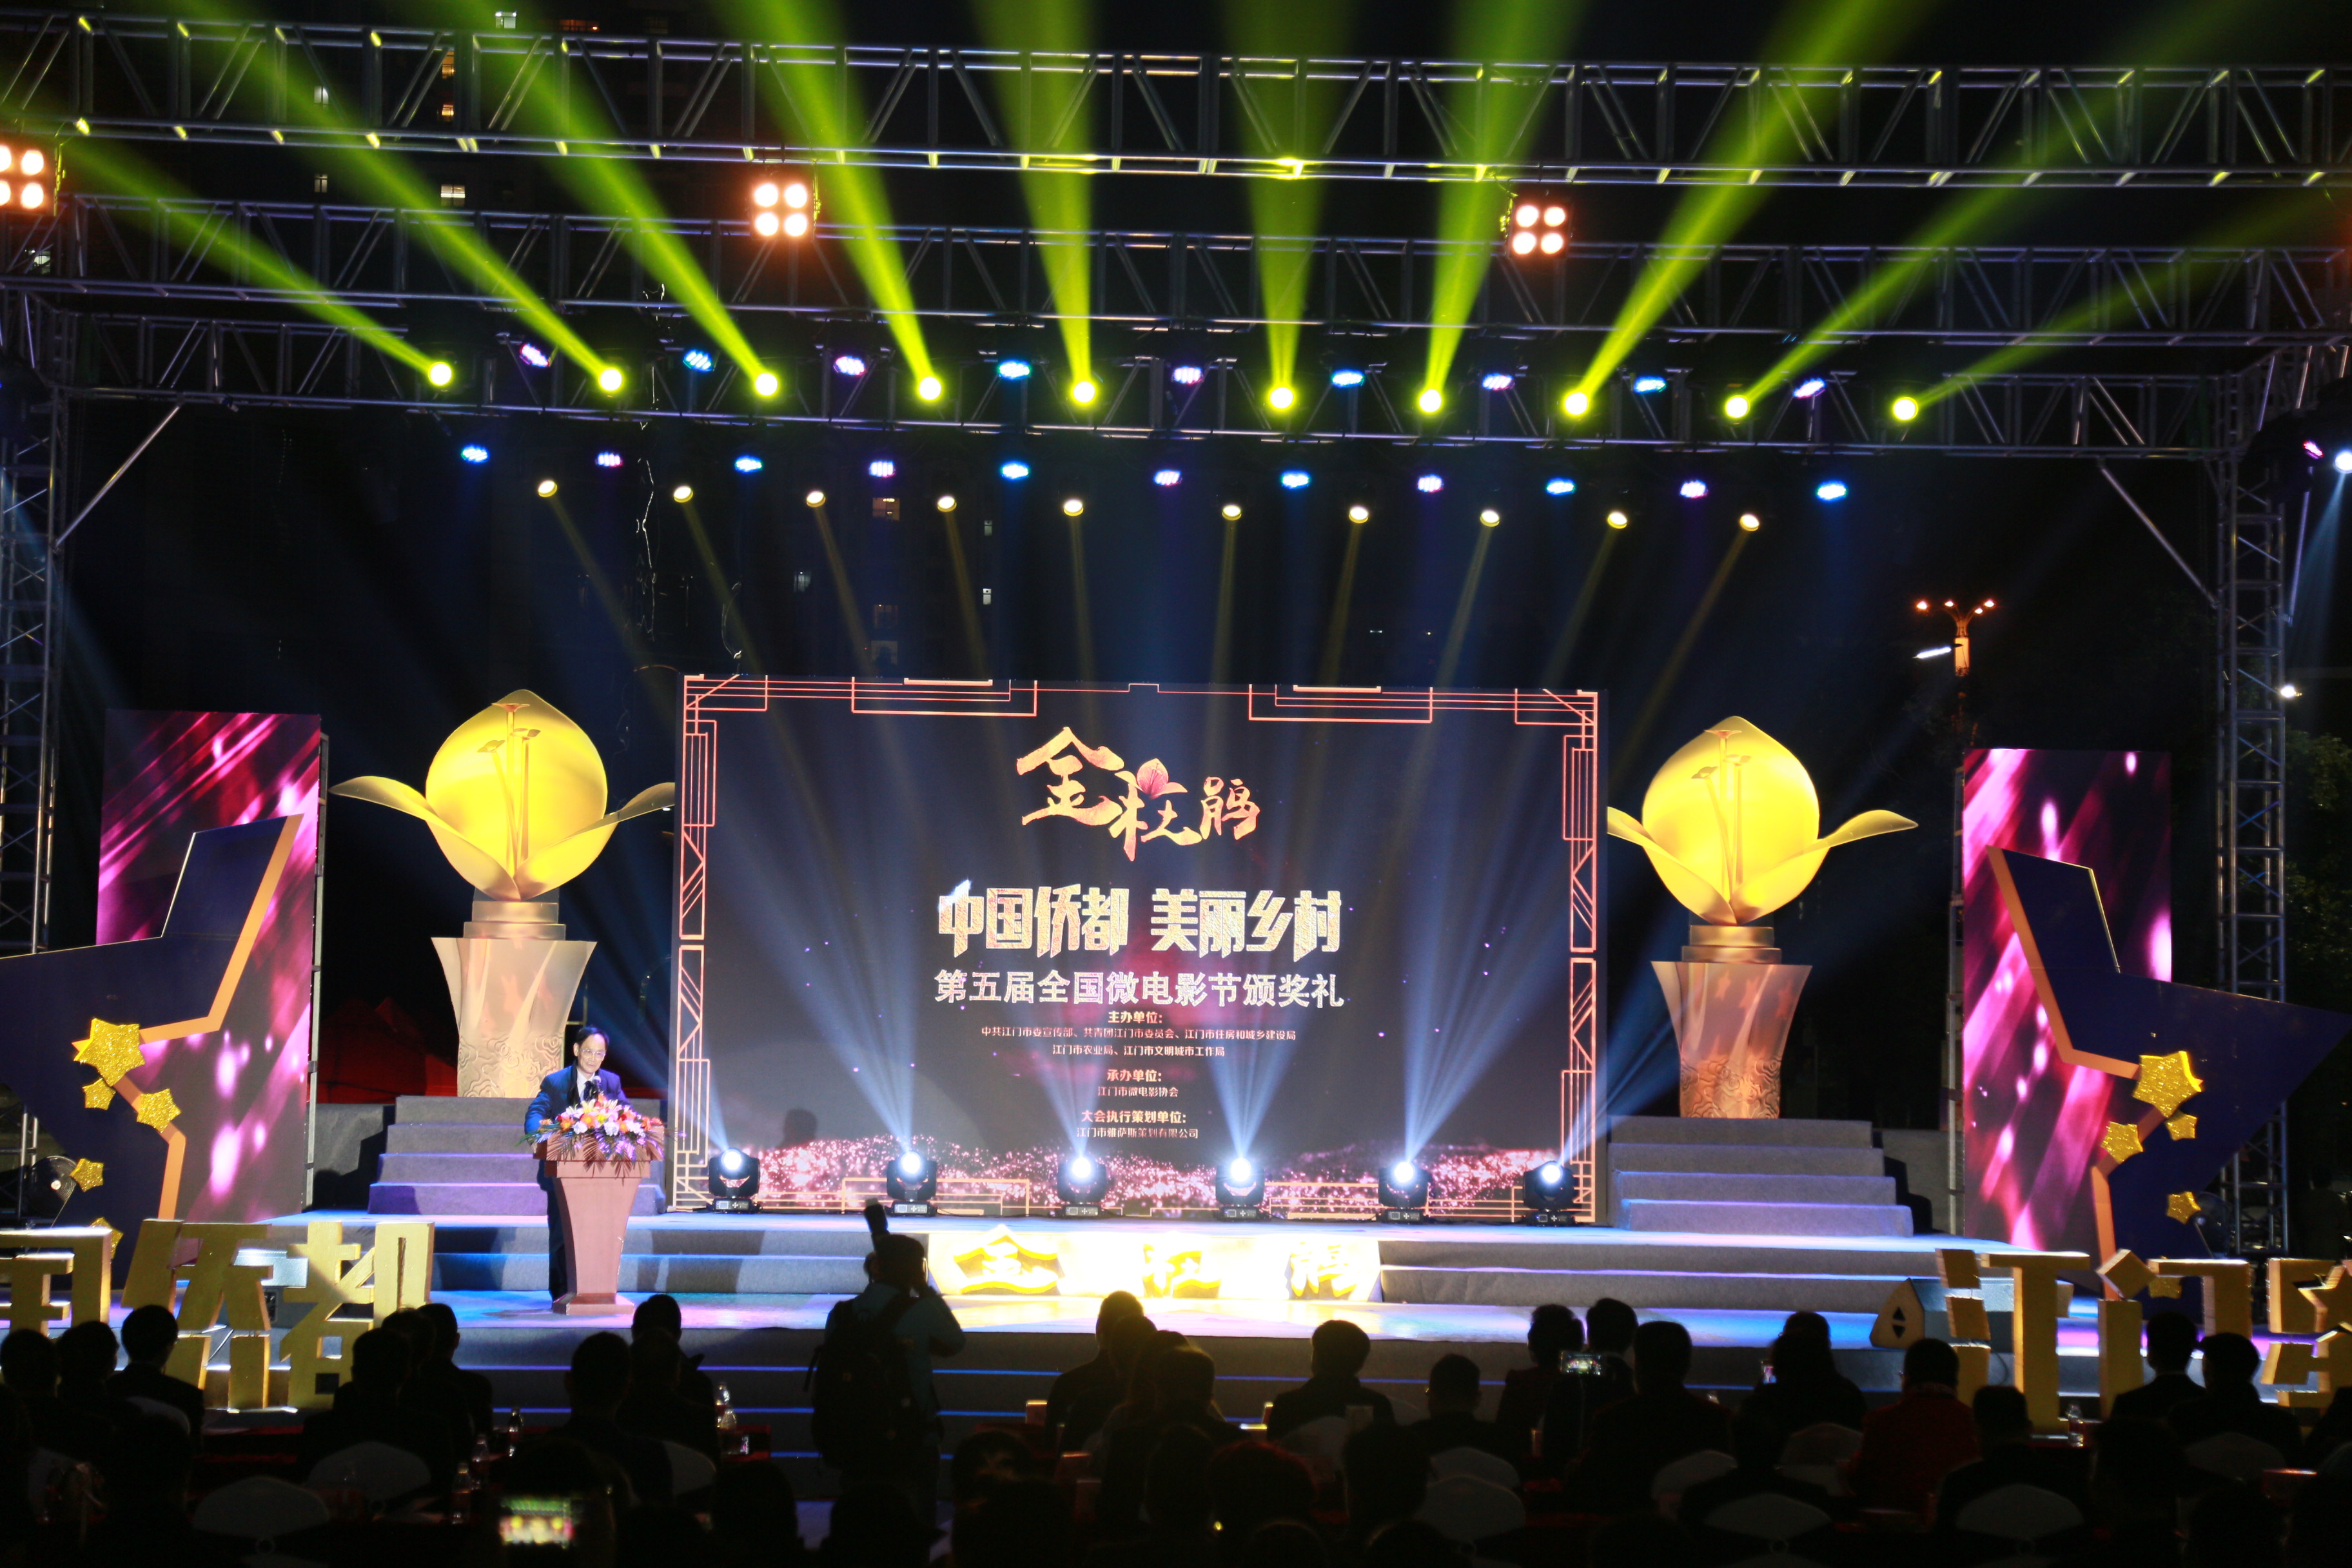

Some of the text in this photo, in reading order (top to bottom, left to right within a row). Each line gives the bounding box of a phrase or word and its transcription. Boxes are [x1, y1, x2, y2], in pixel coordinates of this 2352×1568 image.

[1016, 727, 1261, 862] 金杜鹃
[938, 883, 1342, 963] 中国侨都 美丽乡村
[934, 968, 1345, 1008] 第五届全国微电影节颁奖礼
[1108, 1010, 1162, 1024] 主办单位：
[1106, 1069, 1162, 1083] 承办单位：
[1097, 1086, 1179, 1097] 江门市微电影协会
[1081, 1110, 1186, 1124] 大会执行策划单位：
